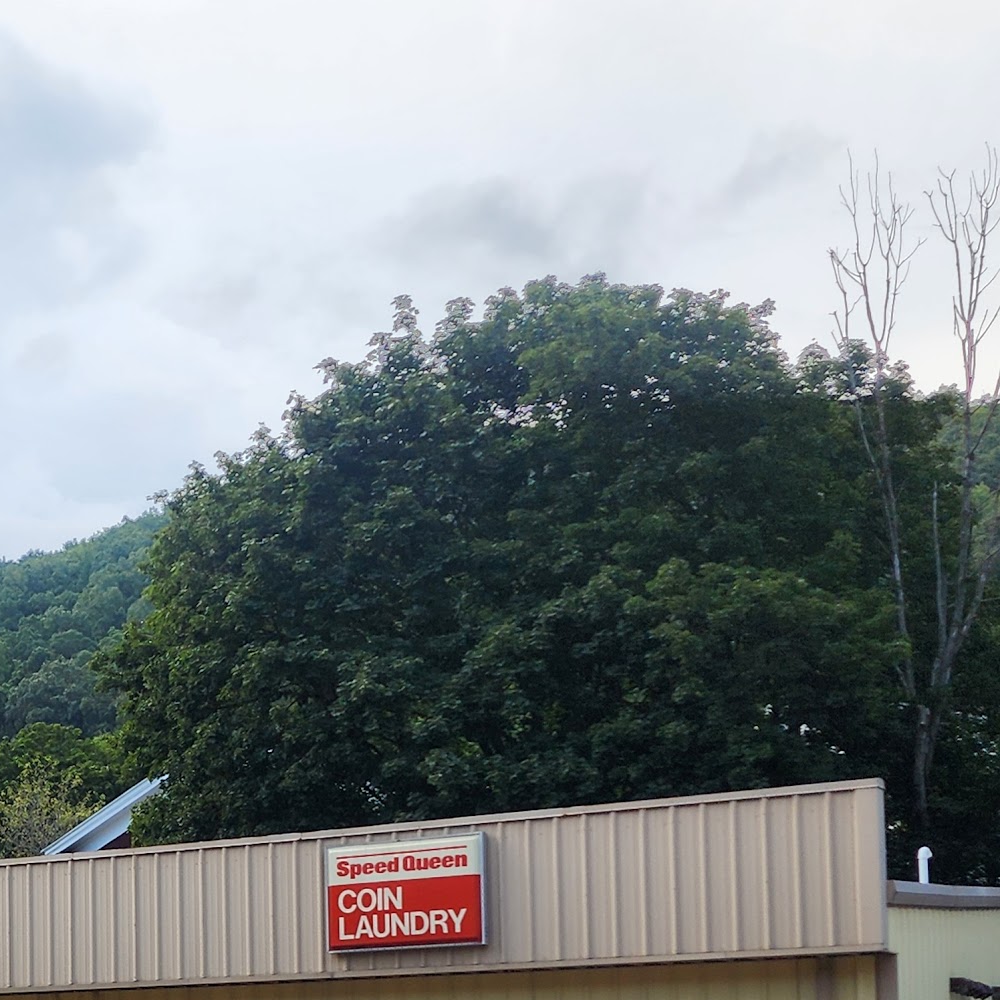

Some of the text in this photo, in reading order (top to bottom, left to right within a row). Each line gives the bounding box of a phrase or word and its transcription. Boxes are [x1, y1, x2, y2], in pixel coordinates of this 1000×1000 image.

[336, 854, 468, 879] Speed Queen
[337, 886, 403, 914] COIN
[338, 908, 467, 941] LAUNDRY
